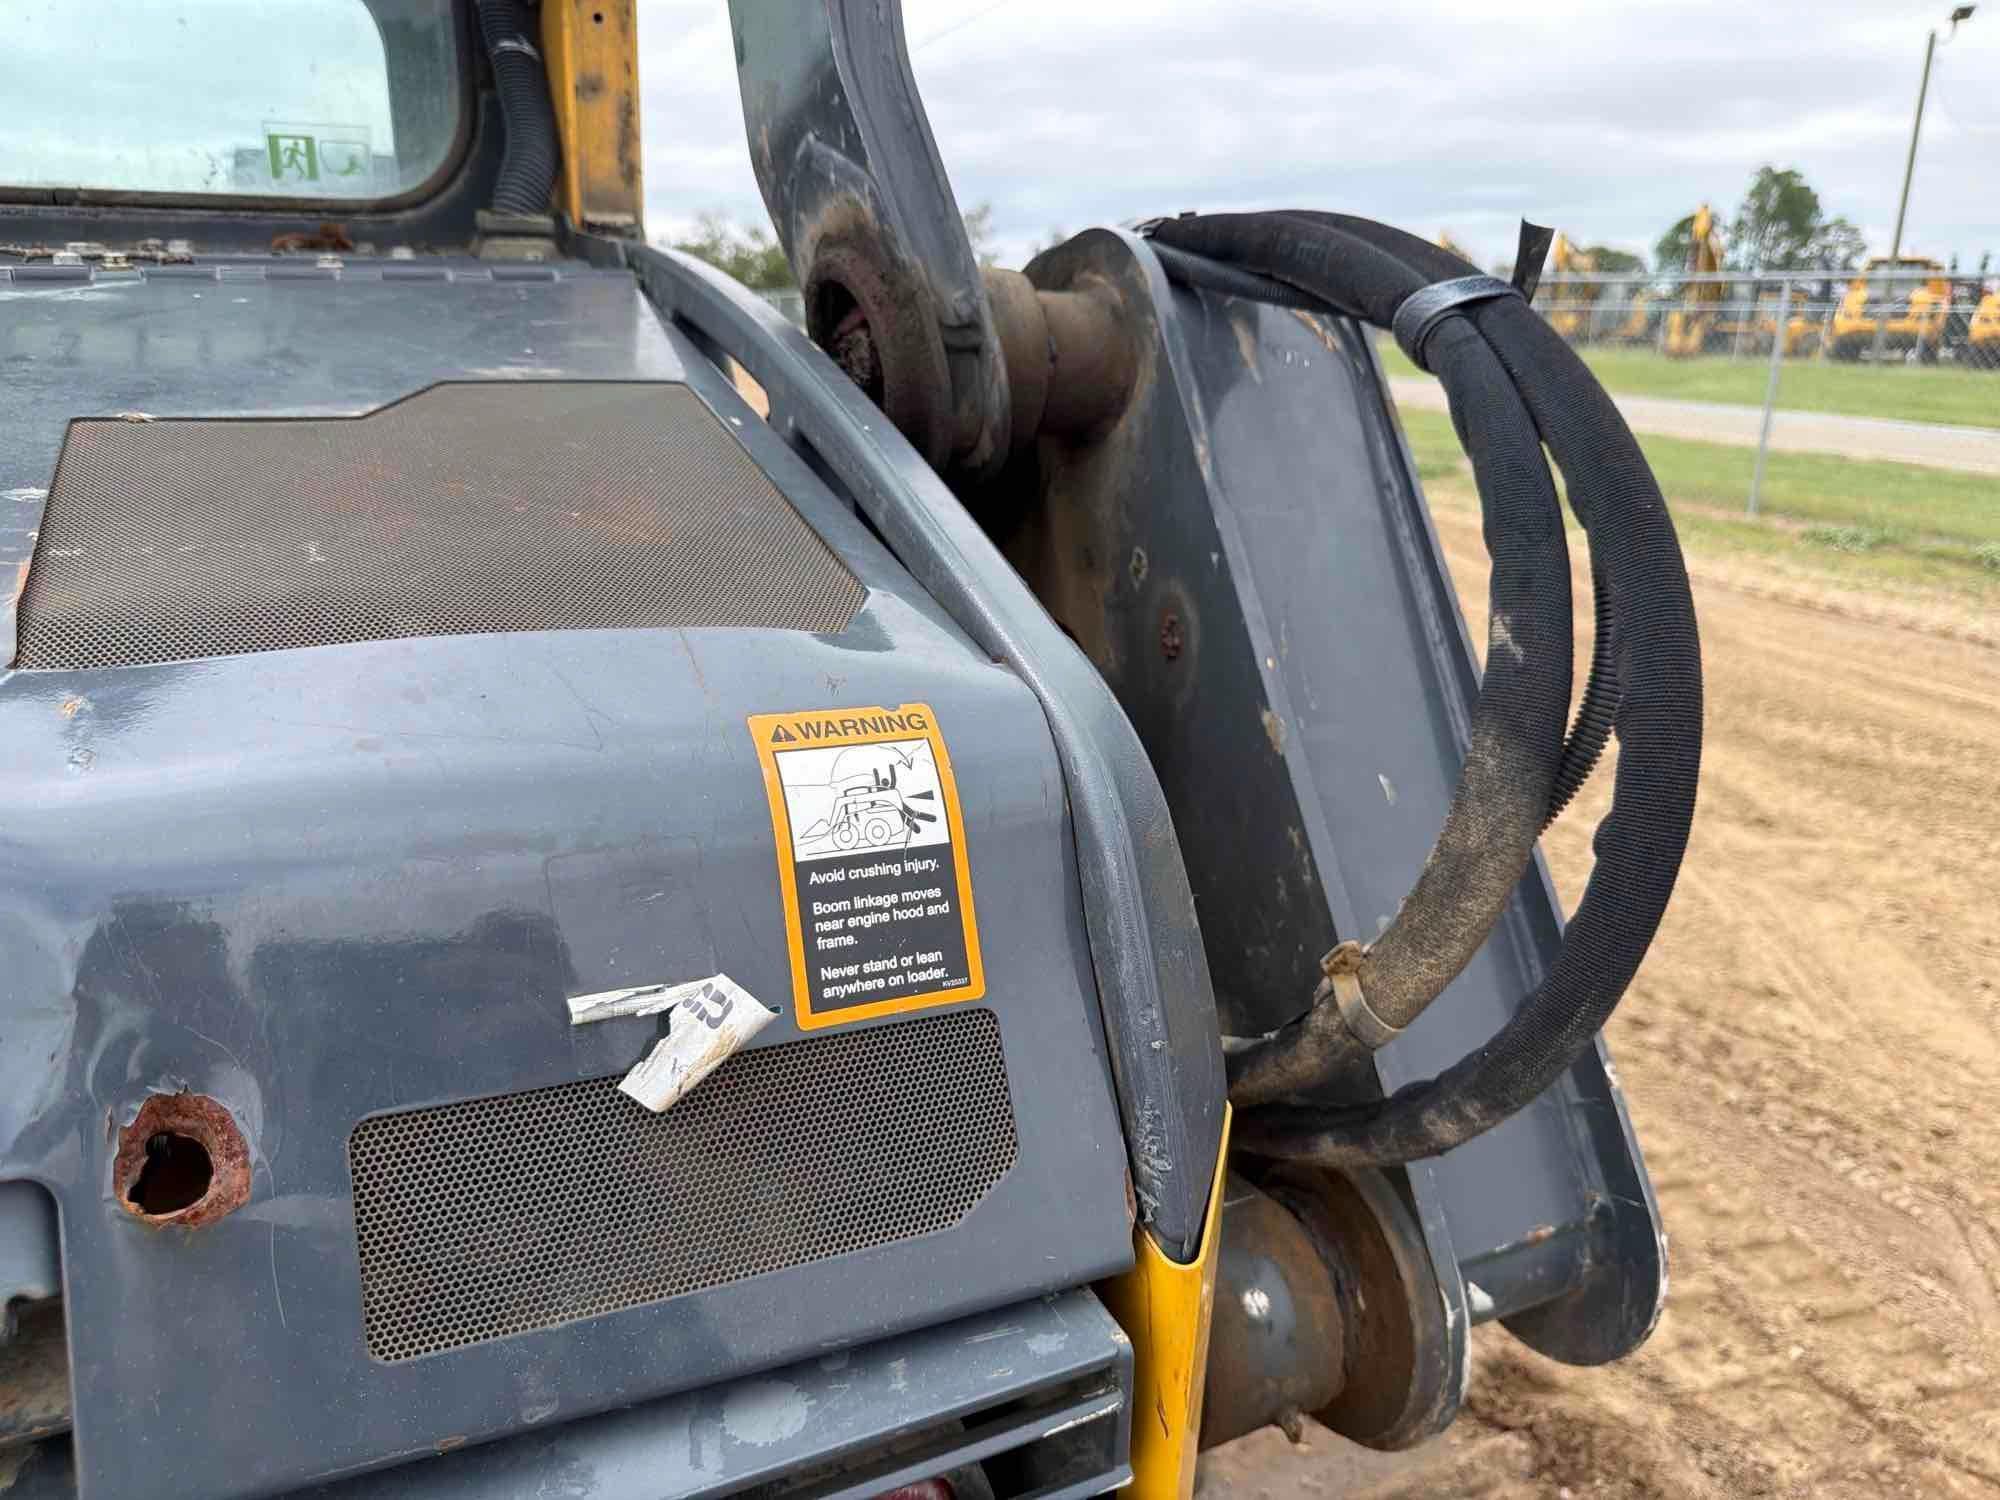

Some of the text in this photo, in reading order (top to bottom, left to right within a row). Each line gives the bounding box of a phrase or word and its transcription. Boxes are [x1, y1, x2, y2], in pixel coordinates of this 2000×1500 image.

[793, 713, 928, 740] WARNING
[809, 858, 940, 885] Avoid crushing injury.
[812, 887, 941, 915] Boom linkage moves
[815, 901, 950, 932] near engine hood and
[817, 934, 858, 950] frame.
[820, 950, 943, 980] Never stand or lean
[823, 979, 885, 998] anywhere
[888, 972, 904, 986] on
[907, 966, 949, 983] loader.
